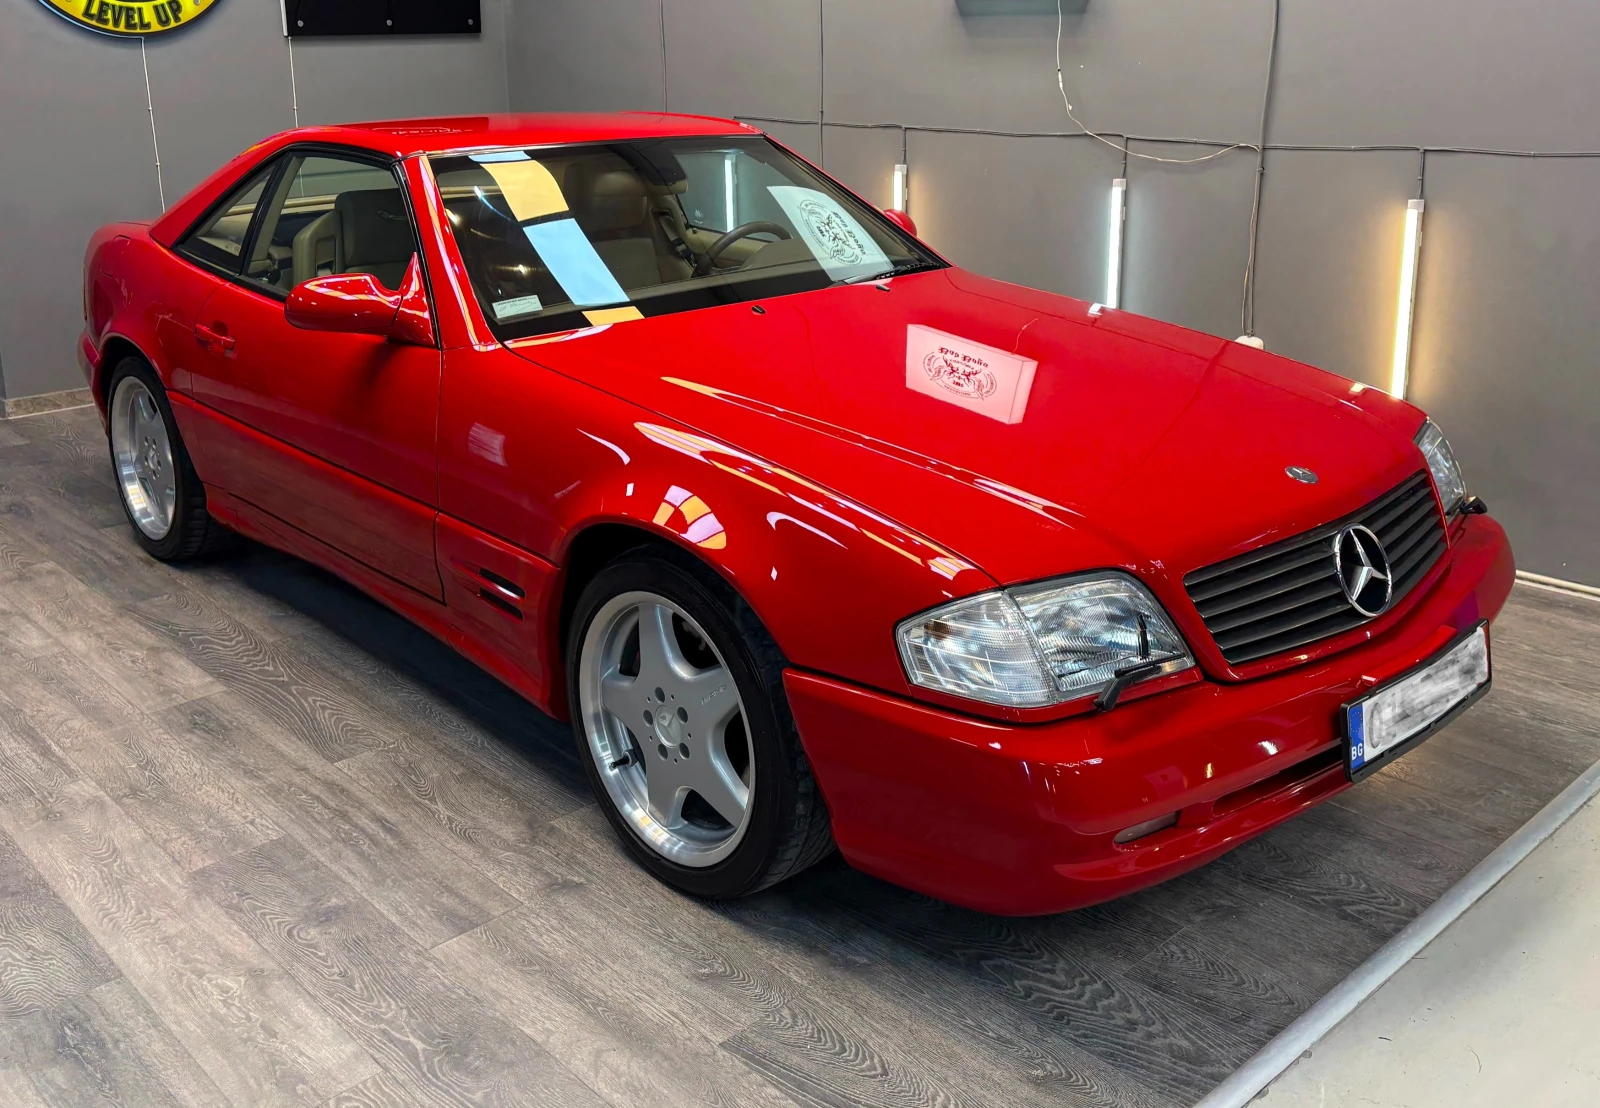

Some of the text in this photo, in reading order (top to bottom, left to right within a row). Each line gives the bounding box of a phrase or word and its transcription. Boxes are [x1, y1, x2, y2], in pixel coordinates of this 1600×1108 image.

[82, 0, 183, 30] LEVEL UP
[1351, 744, 1363, 760] BG
